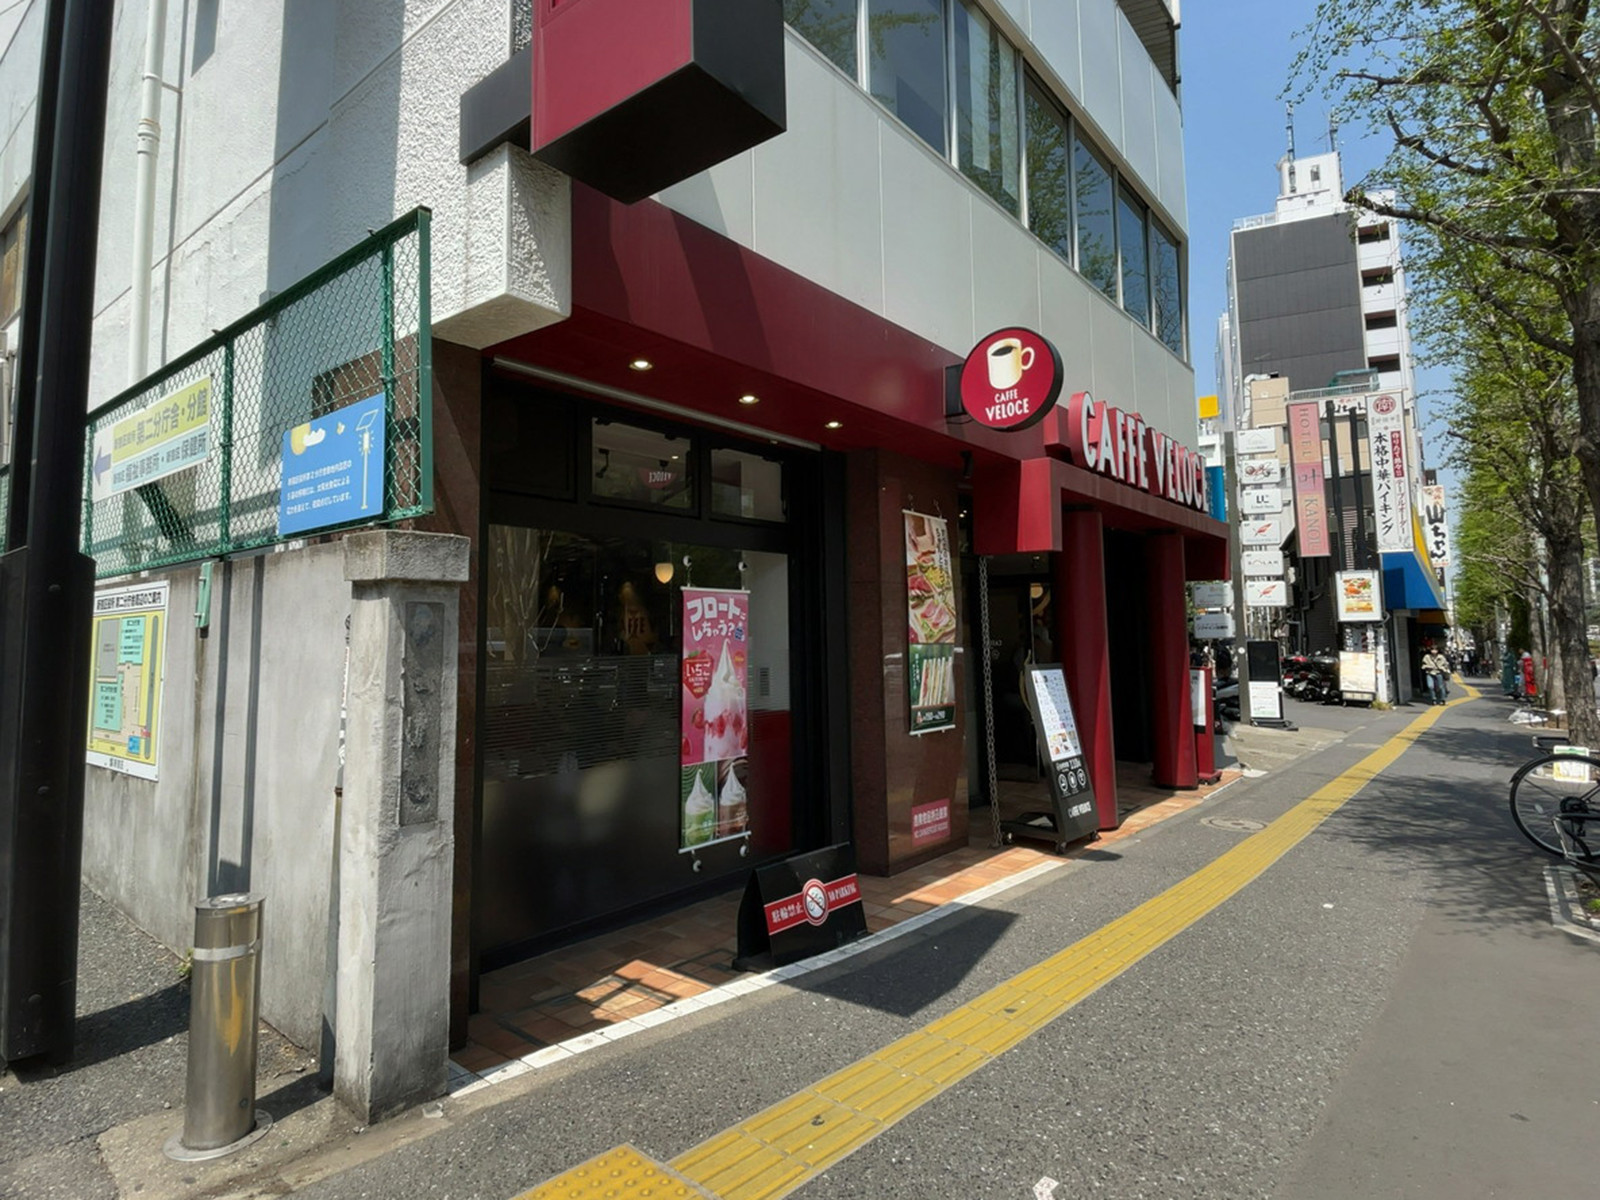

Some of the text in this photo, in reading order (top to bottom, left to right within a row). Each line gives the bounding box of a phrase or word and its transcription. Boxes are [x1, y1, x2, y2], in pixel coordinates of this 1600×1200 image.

[985, 398, 1030, 421] VELOCE
[1299, 407, 1312, 458] HOTEL
[1374, 432, 1394, 536] 本格中華バイキング
[1426, 504, 1447, 559] 山ちゃん
[686, 662, 711, 677] いちご
